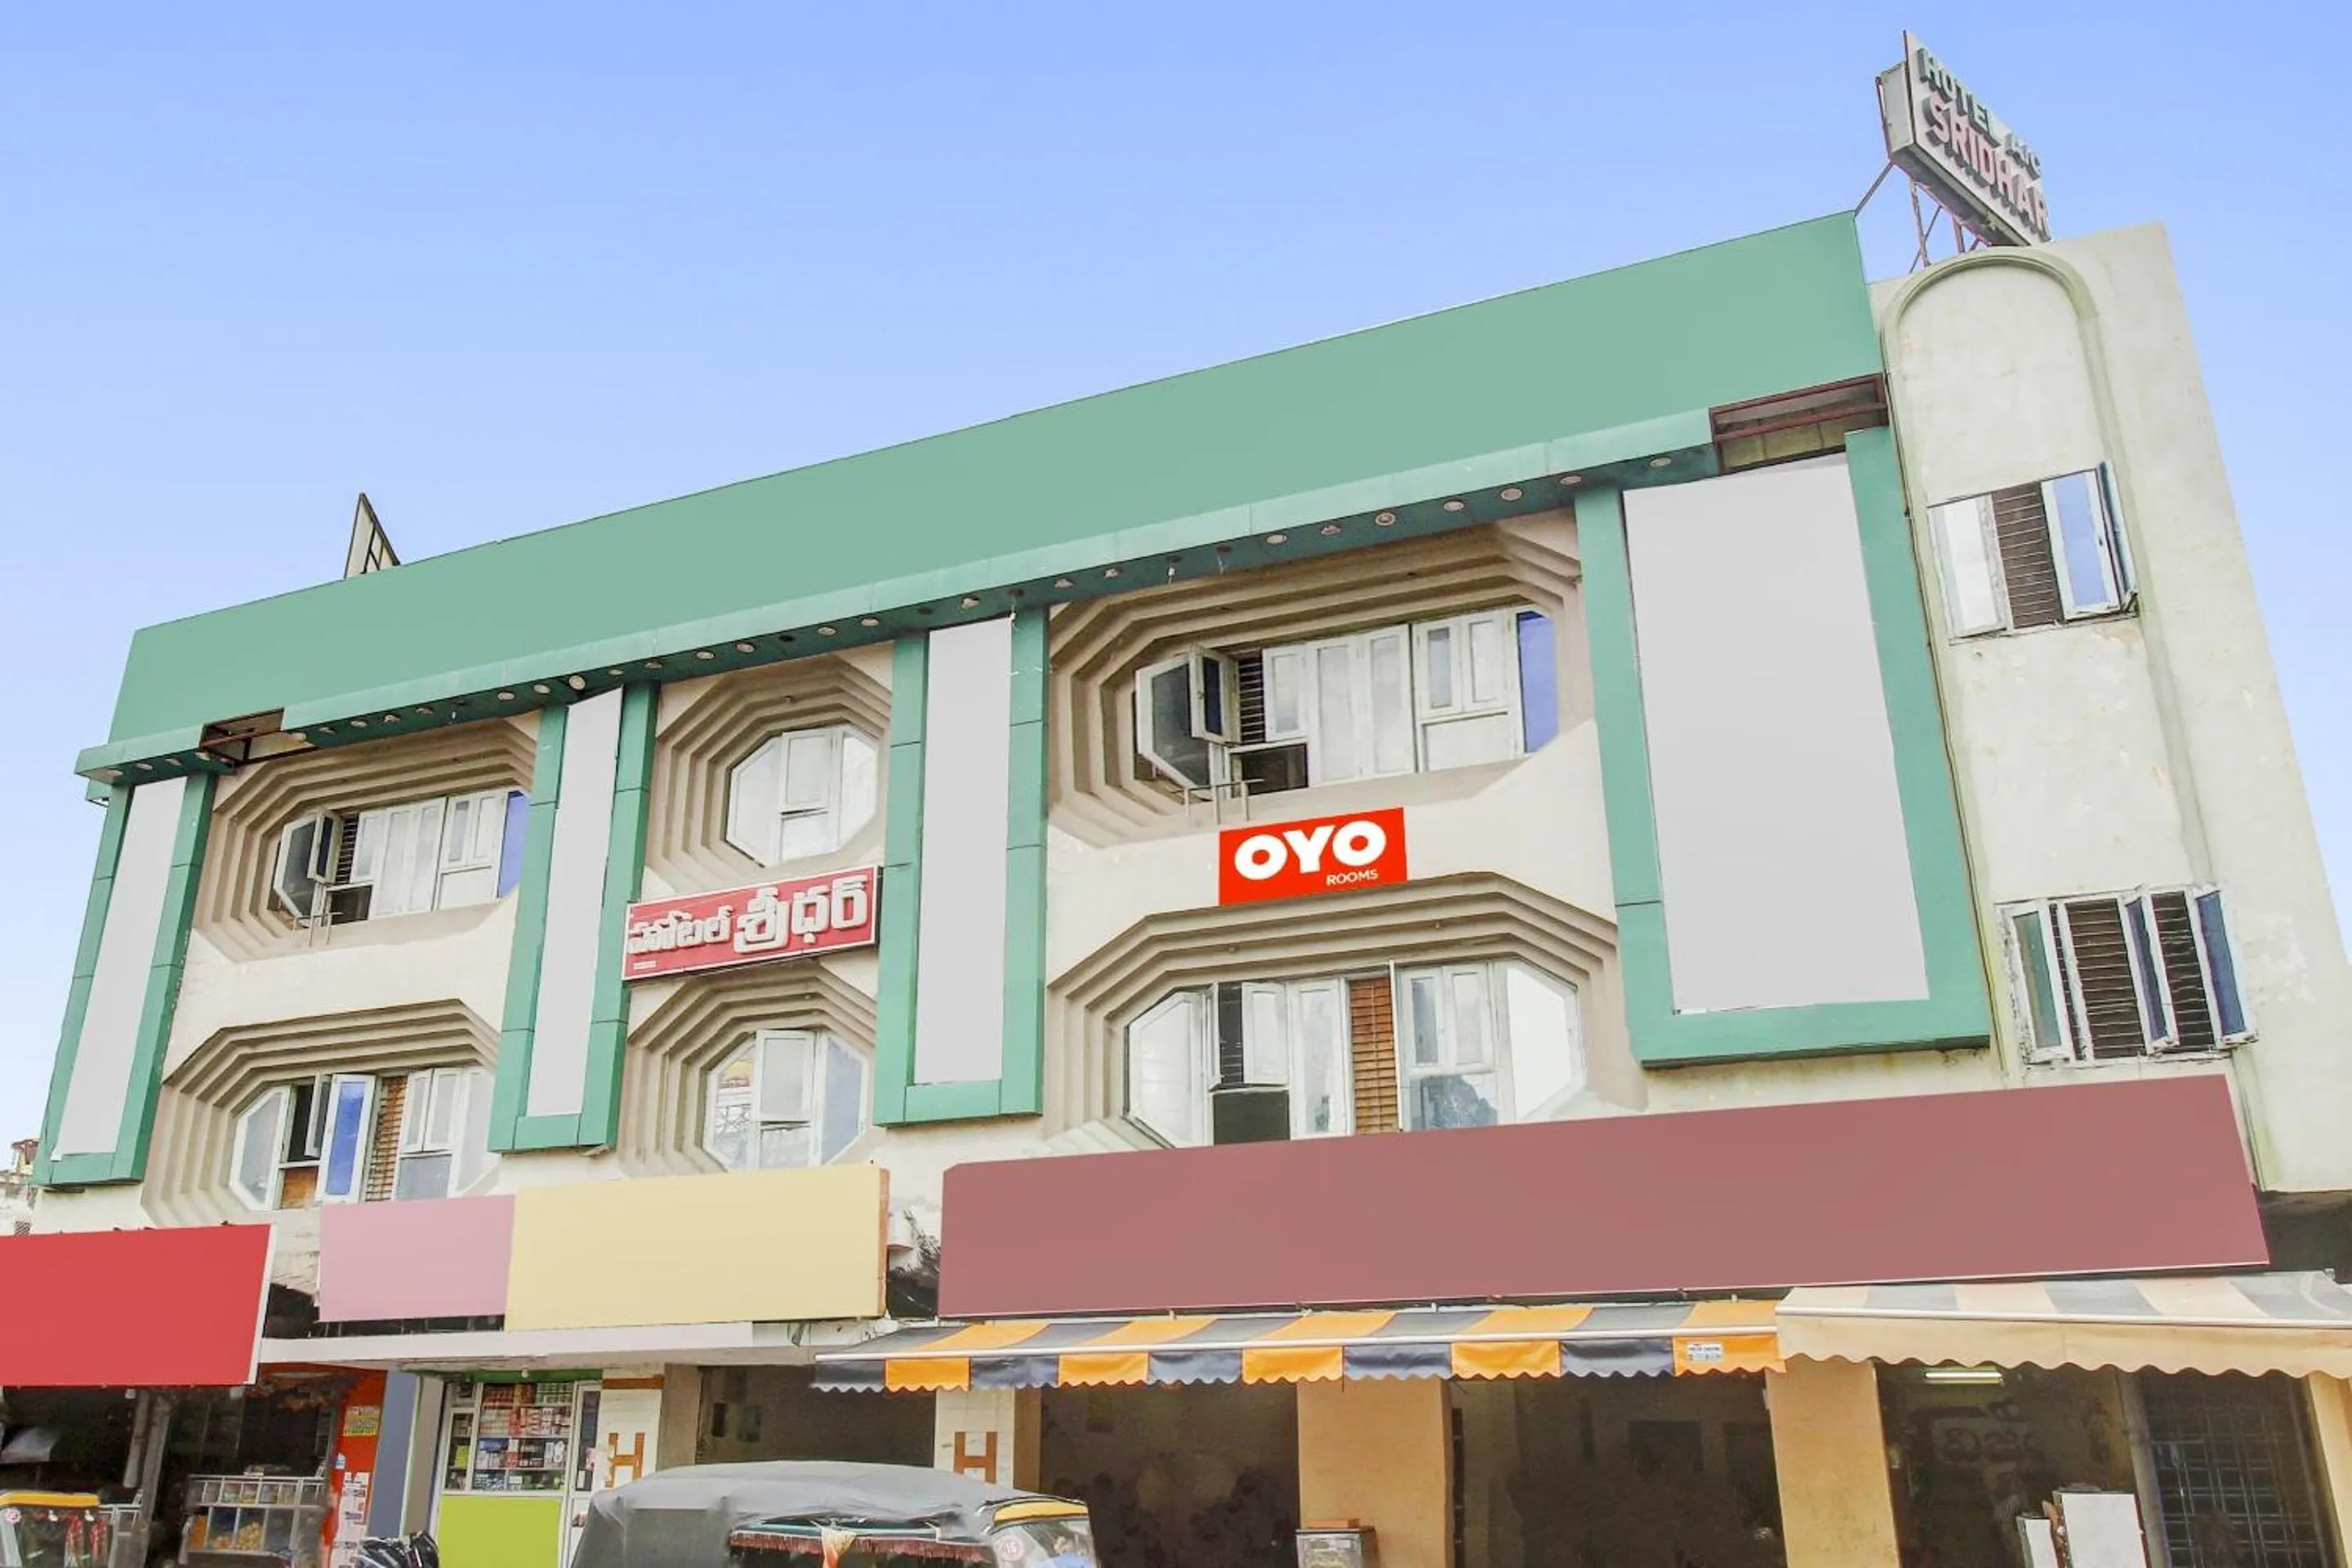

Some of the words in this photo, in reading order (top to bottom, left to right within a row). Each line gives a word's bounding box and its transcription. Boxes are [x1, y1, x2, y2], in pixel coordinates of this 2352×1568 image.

[1918, 47, 2003, 149] HOTEL
[1922, 94, 2052, 242] SRIDHAR
[1234, 820, 1387, 880] OYO
[1326, 868, 1379, 886] ROOMS
